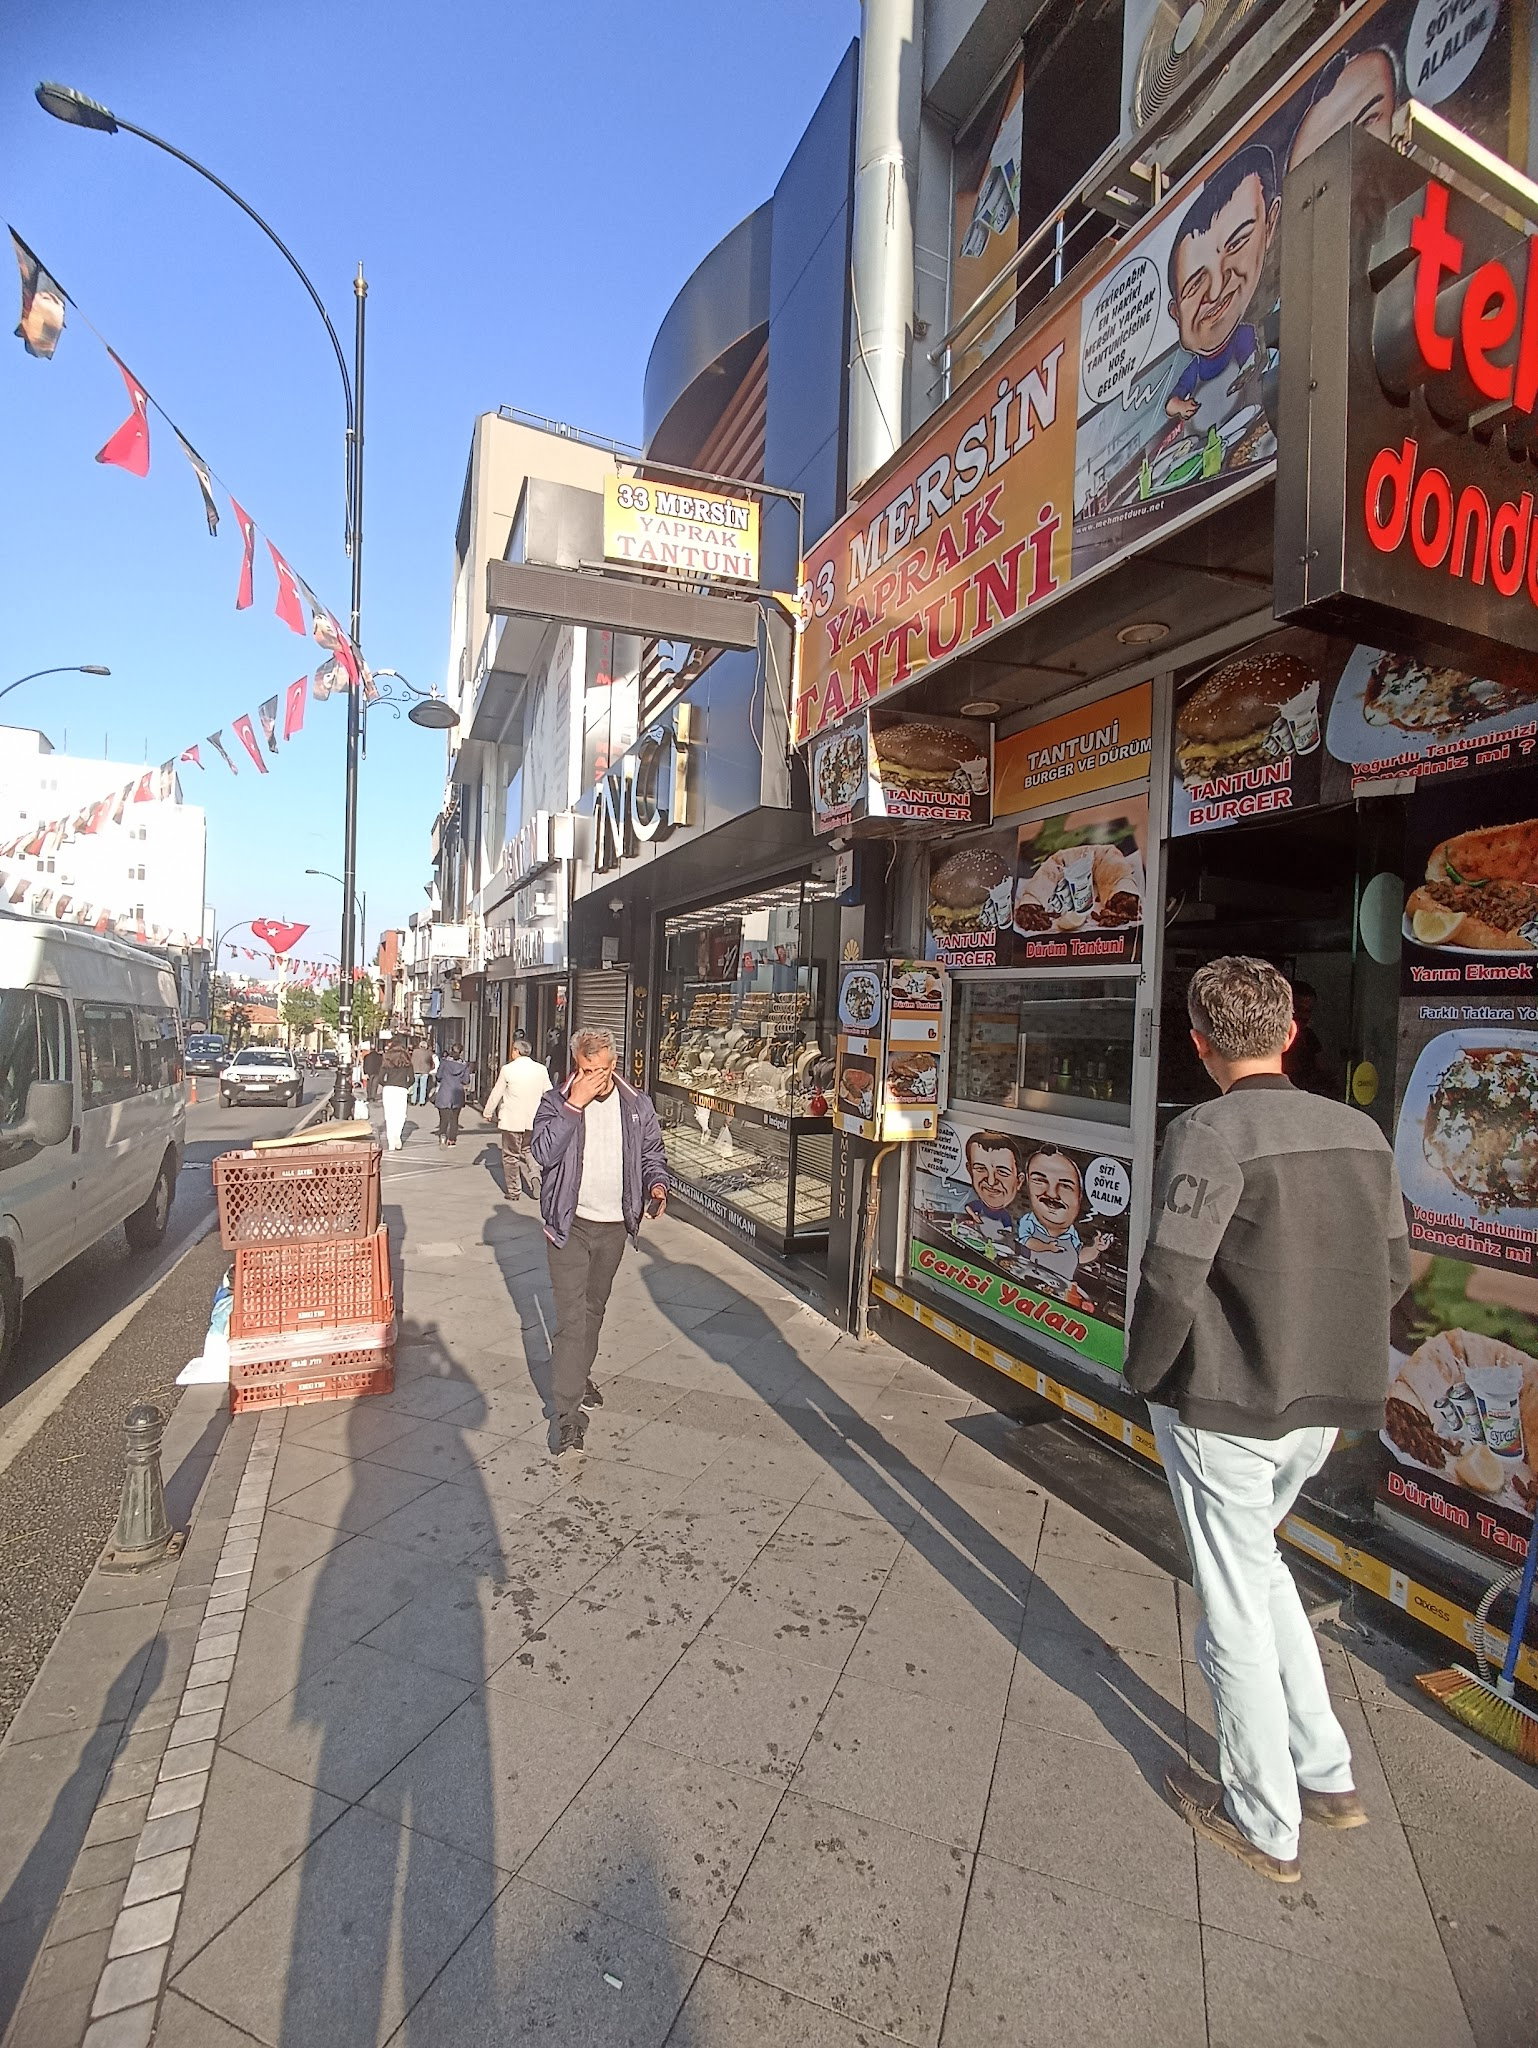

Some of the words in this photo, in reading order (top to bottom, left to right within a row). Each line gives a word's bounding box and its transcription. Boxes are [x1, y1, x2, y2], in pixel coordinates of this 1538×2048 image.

[1095, 261, 1147, 318] TEKİRDAĞIN
[1098, 316, 1109, 332] EN
[1111, 281, 1142, 320] HAKİKİ
[1084, 324, 1116, 361] MERSİN
[1118, 288, 1156, 330] YAPRAK
[1087, 308, 1151, 374] TANTUNİCİSİNE
[1097, 357, 1136, 398] GELDİNİZ
[1108, 348, 1126, 373] HOŞ
[846, 341, 1066, 593] MERSİN
[617, 483, 650, 512] 33
[655, 490, 750, 531] MERSİN
[639, 516, 737, 548] YAPRAK
[617, 535, 752, 578] TANTUNİ
[825, 480, 1005, 658] YAPRAK
[797, 502, 1064, 740] TANTUNİ
[1024, 763, 1075, 789] BURGER
[1078, 755, 1096, 772] VE
[1099, 737, 1152, 766] DÜRÜM
[1027, 718, 1120, 771] TANTUNİ
[1351, 751, 1420, 775] Yoğurtlu
[1425, 720, 1538, 758] Tantunimizi
[1476, 744, 1510, 764] mi
[886, 789, 970, 806] TANTUNİ
[1190, 756, 1292, 802] TANTUNİ
[886, 804, 972, 821] BURGER
[1189, 787, 1293, 827] BURGER
[934, 928, 996, 950] TANTUNİ
[935, 951, 997, 967] BURGER
[1026, 941, 1067, 958] Dürüm
[1070, 936, 1124, 956] Tantuni
[1410, 966, 1460, 981] Yarım
[1465, 963, 1533, 981] Ekmek
[1419, 1006, 1458, 1020] Farklı
[1462, 1006, 1514, 1020] Tatlara
[1094, 1176, 1121, 1191] ŞÖYLE
[1099, 1163, 1116, 1177] SİZİ
[1166, 1173, 1231, 1225] CK
[1412, 1205, 1465, 1229] Yoğurtlu
[1412, 1223, 1501, 1257] Denediniz
[1505, 1246, 1531, 1264] mi
[918, 1249, 994, 1296] Gerisi
[1388, 1471, 1469, 1529] Dürüm
[1414, 1595, 1450, 1622] axess
